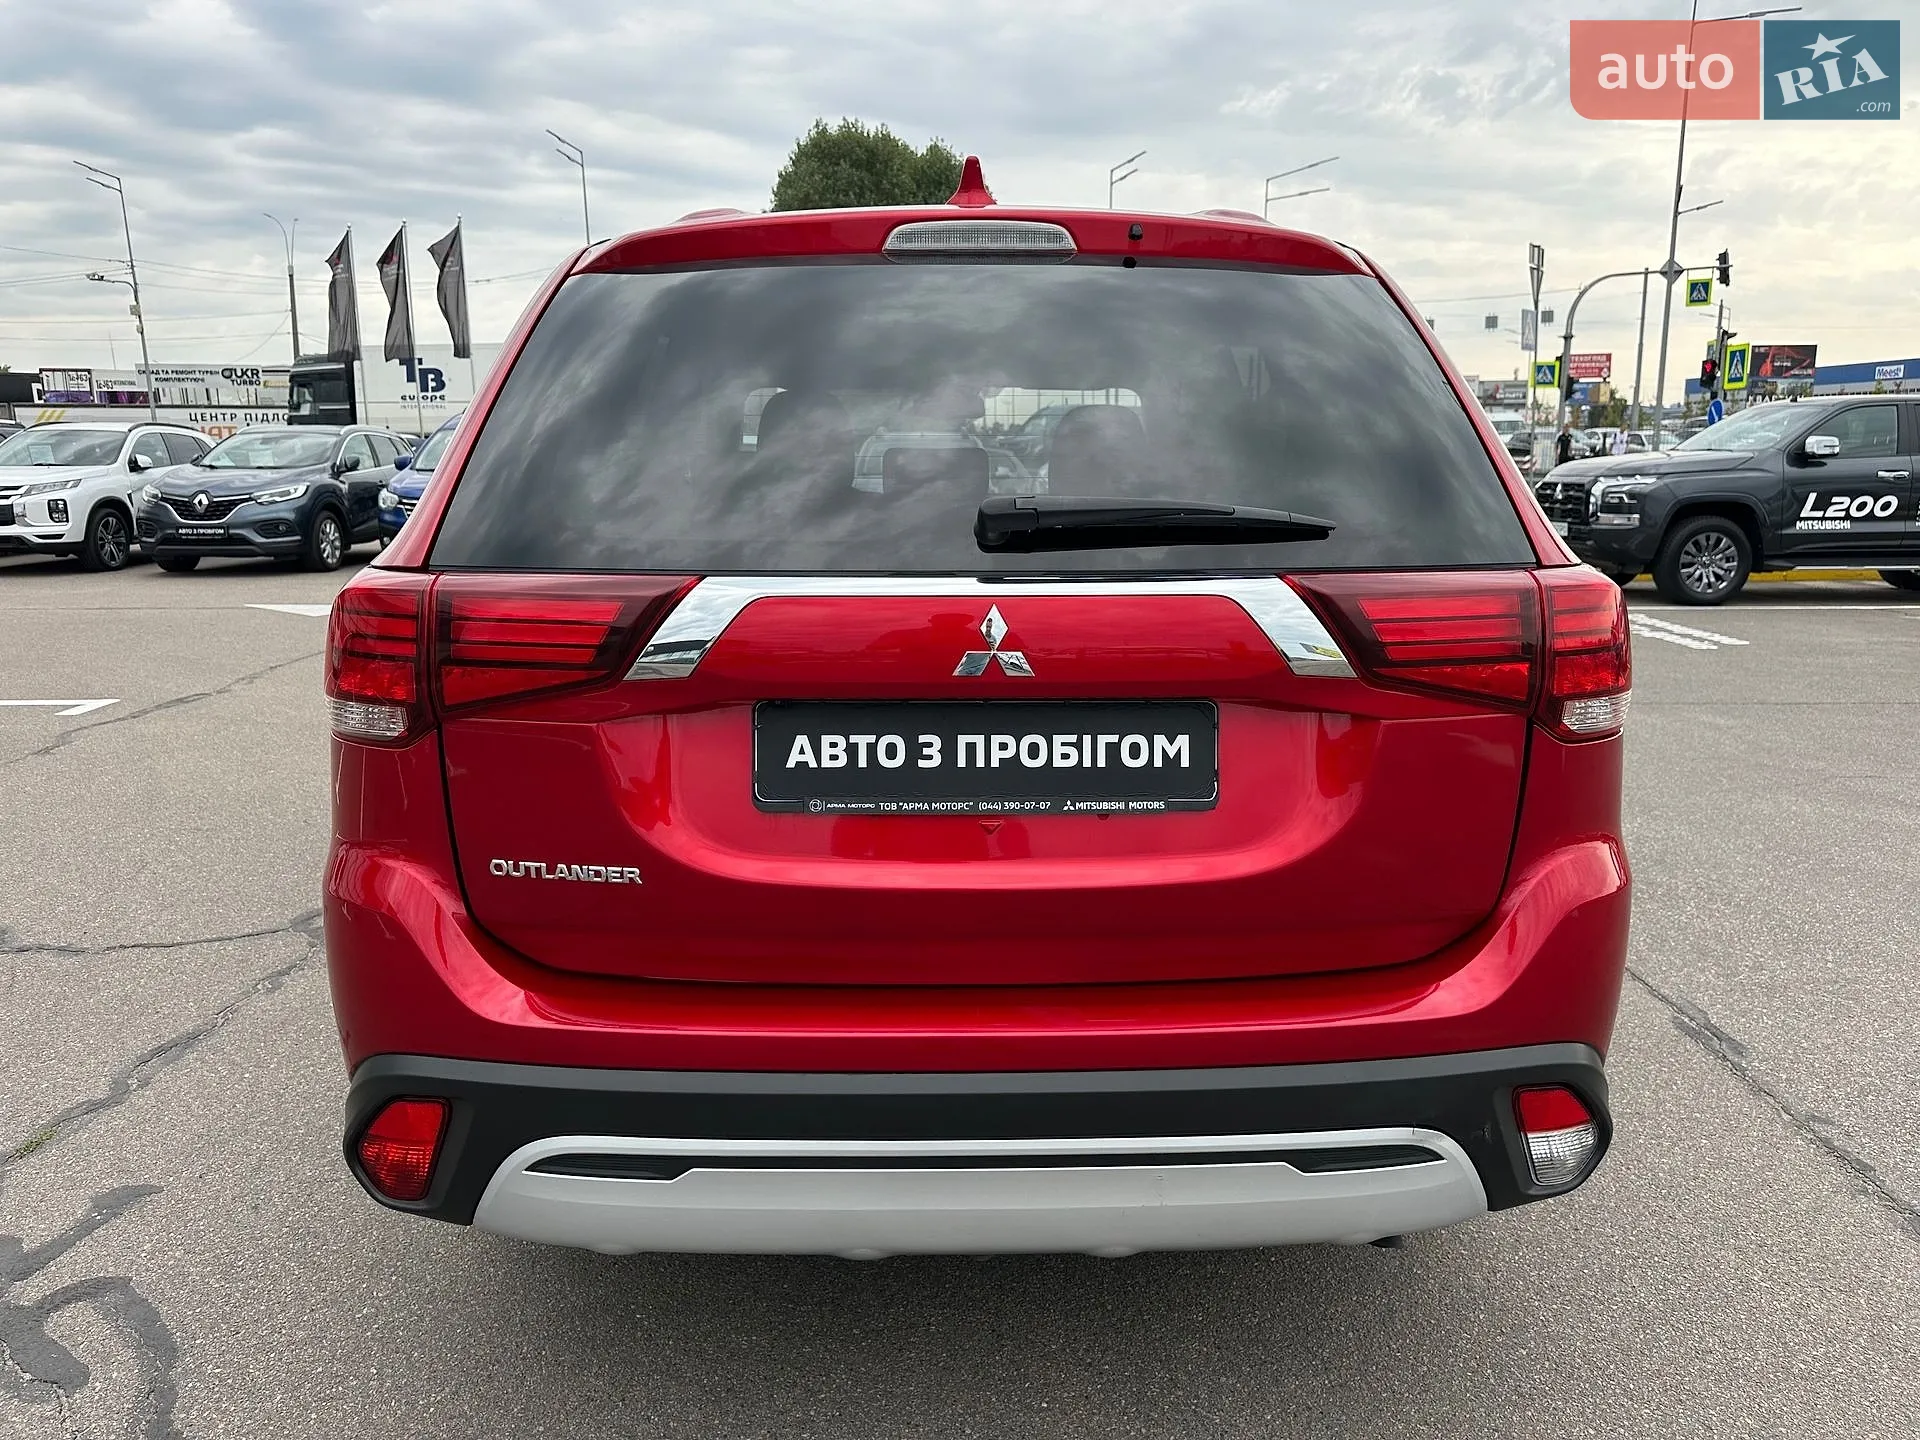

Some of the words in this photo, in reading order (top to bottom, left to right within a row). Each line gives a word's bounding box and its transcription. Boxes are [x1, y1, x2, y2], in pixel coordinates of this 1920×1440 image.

[189, 412, 237, 422] ЦЕНТР
[1800, 492, 1899, 518] L200
[1796, 520, 1851, 530] MITSUBISHI
[785, 734, 907, 768] АВТО
[917, 734, 942, 768] З
[957, 734, 1190, 768] ПРОБІГОМ
[879, 802, 898, 811] ТОВ
[899, 802, 931, 811] "АРМА
[932, 802, 974, 811] МОТОРС"
[979, 802, 1002, 811] (044)
[1003, 802, 1051, 810] 390-07-07
[1075, 802, 1125, 810] MITSUBISHI
[1128, 802, 1166, 810] MOTORS
[489, 858, 643, 885] OUTLANDER
